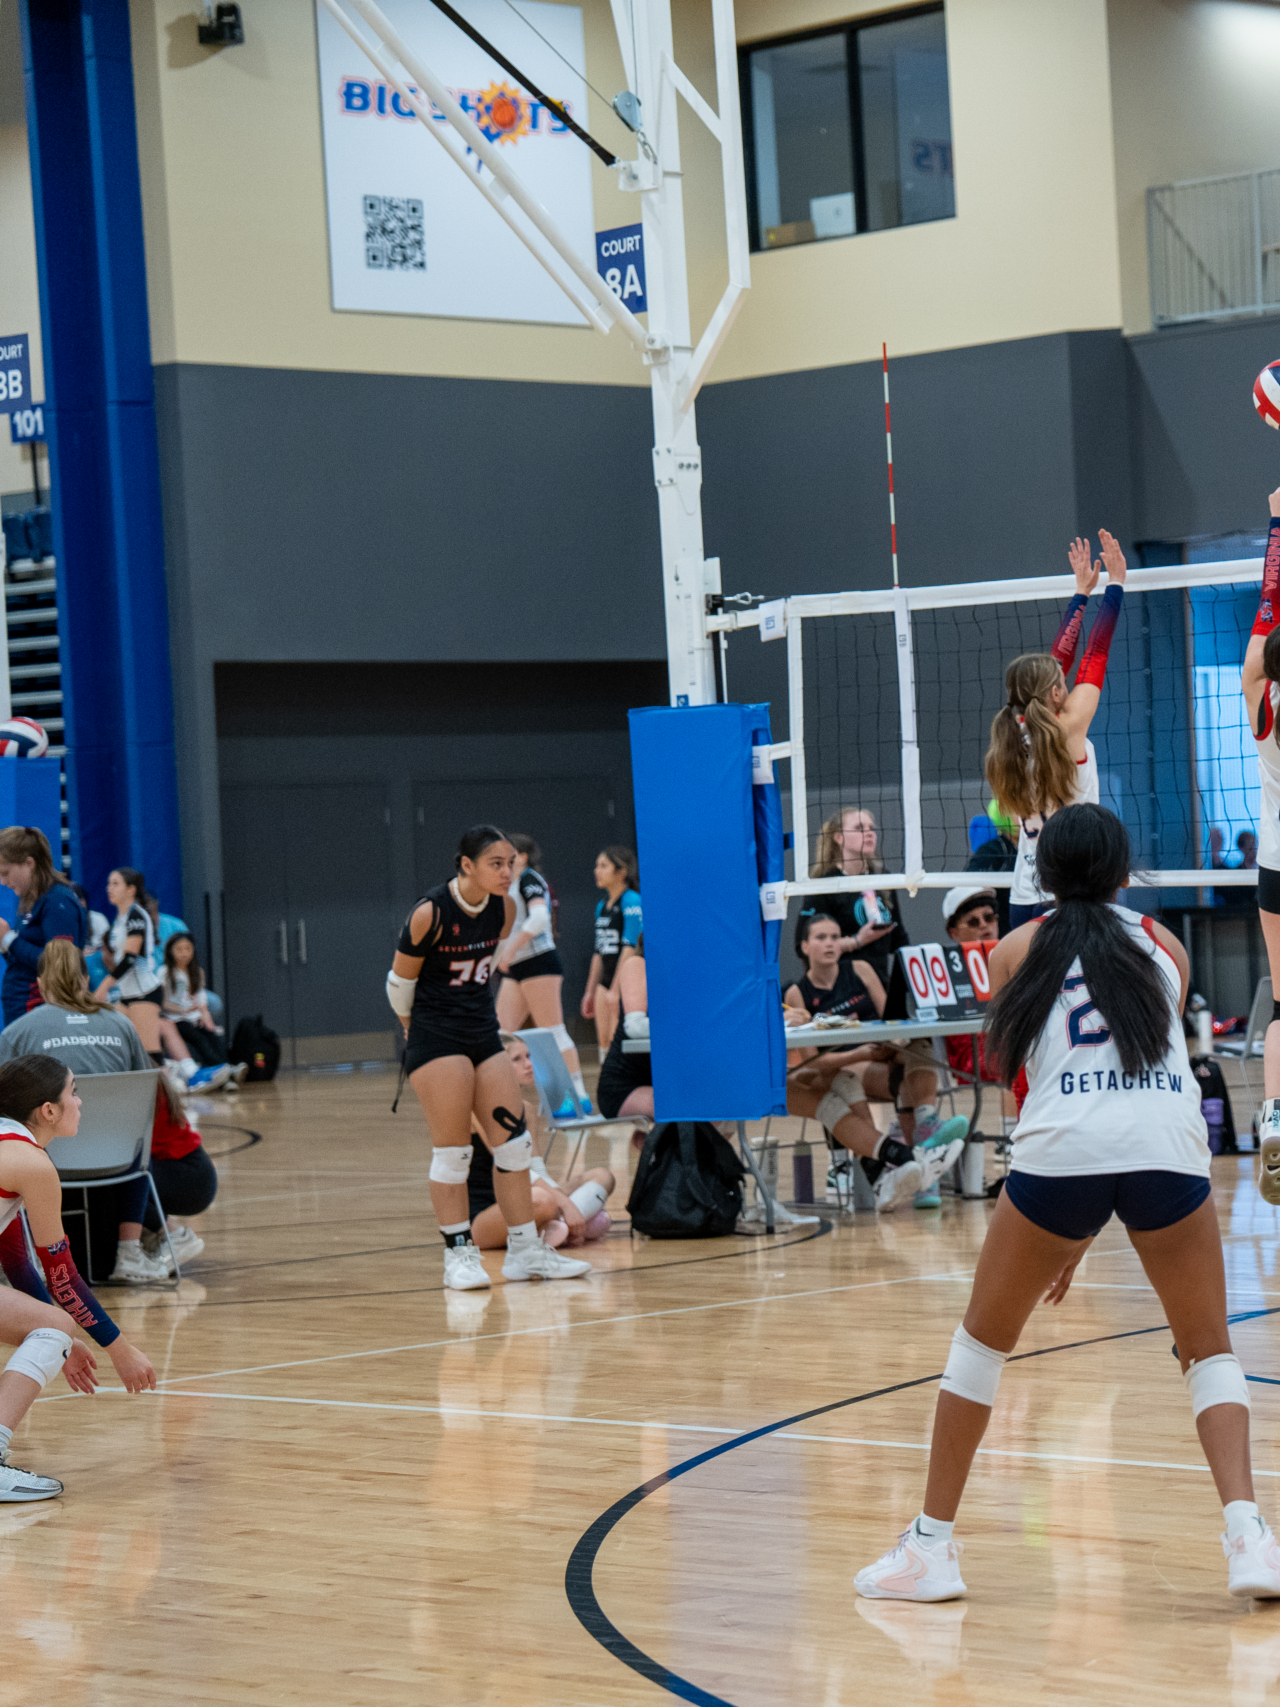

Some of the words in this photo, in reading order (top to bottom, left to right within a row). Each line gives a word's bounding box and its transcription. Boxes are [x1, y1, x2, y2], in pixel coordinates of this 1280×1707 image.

[601, 234, 641, 257] COURT
[605, 263, 643, 299] 8A
[949, 950, 963, 973] 3
[909, 956, 950, 998] 09
[1060, 973, 1113, 1051] 2
[43, 1034, 122, 1050] #DADSQUAD
[1060, 1070, 1182, 1094] GETACHEW
[50, 1264, 98, 1327] ATHLETCS
